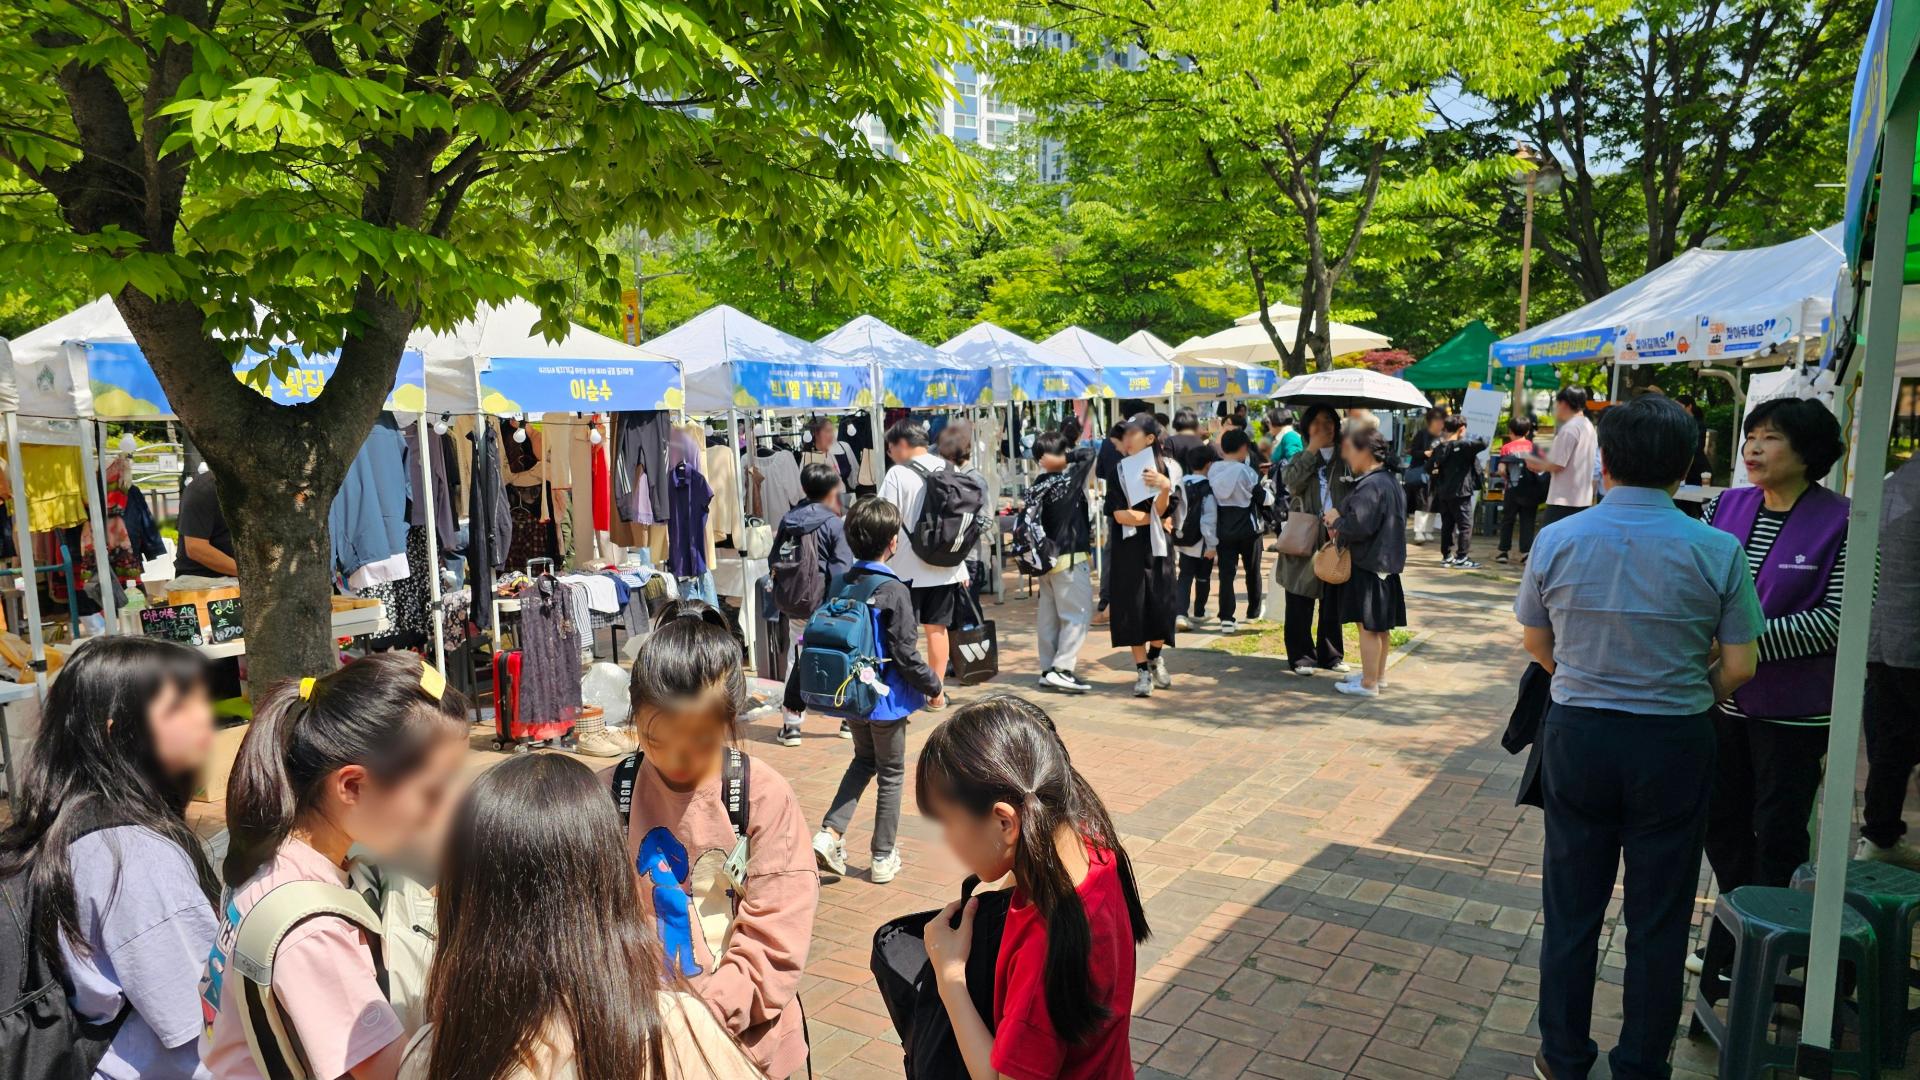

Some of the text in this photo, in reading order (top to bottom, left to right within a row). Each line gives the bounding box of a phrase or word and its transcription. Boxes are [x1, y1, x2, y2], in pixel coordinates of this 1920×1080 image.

[1726, 323, 1764, 340] 찾아주세요
[569, 378, 613, 402] 이순수
[619, 780, 632, 813] MSGM
[730, 779, 741, 812] MSGM
